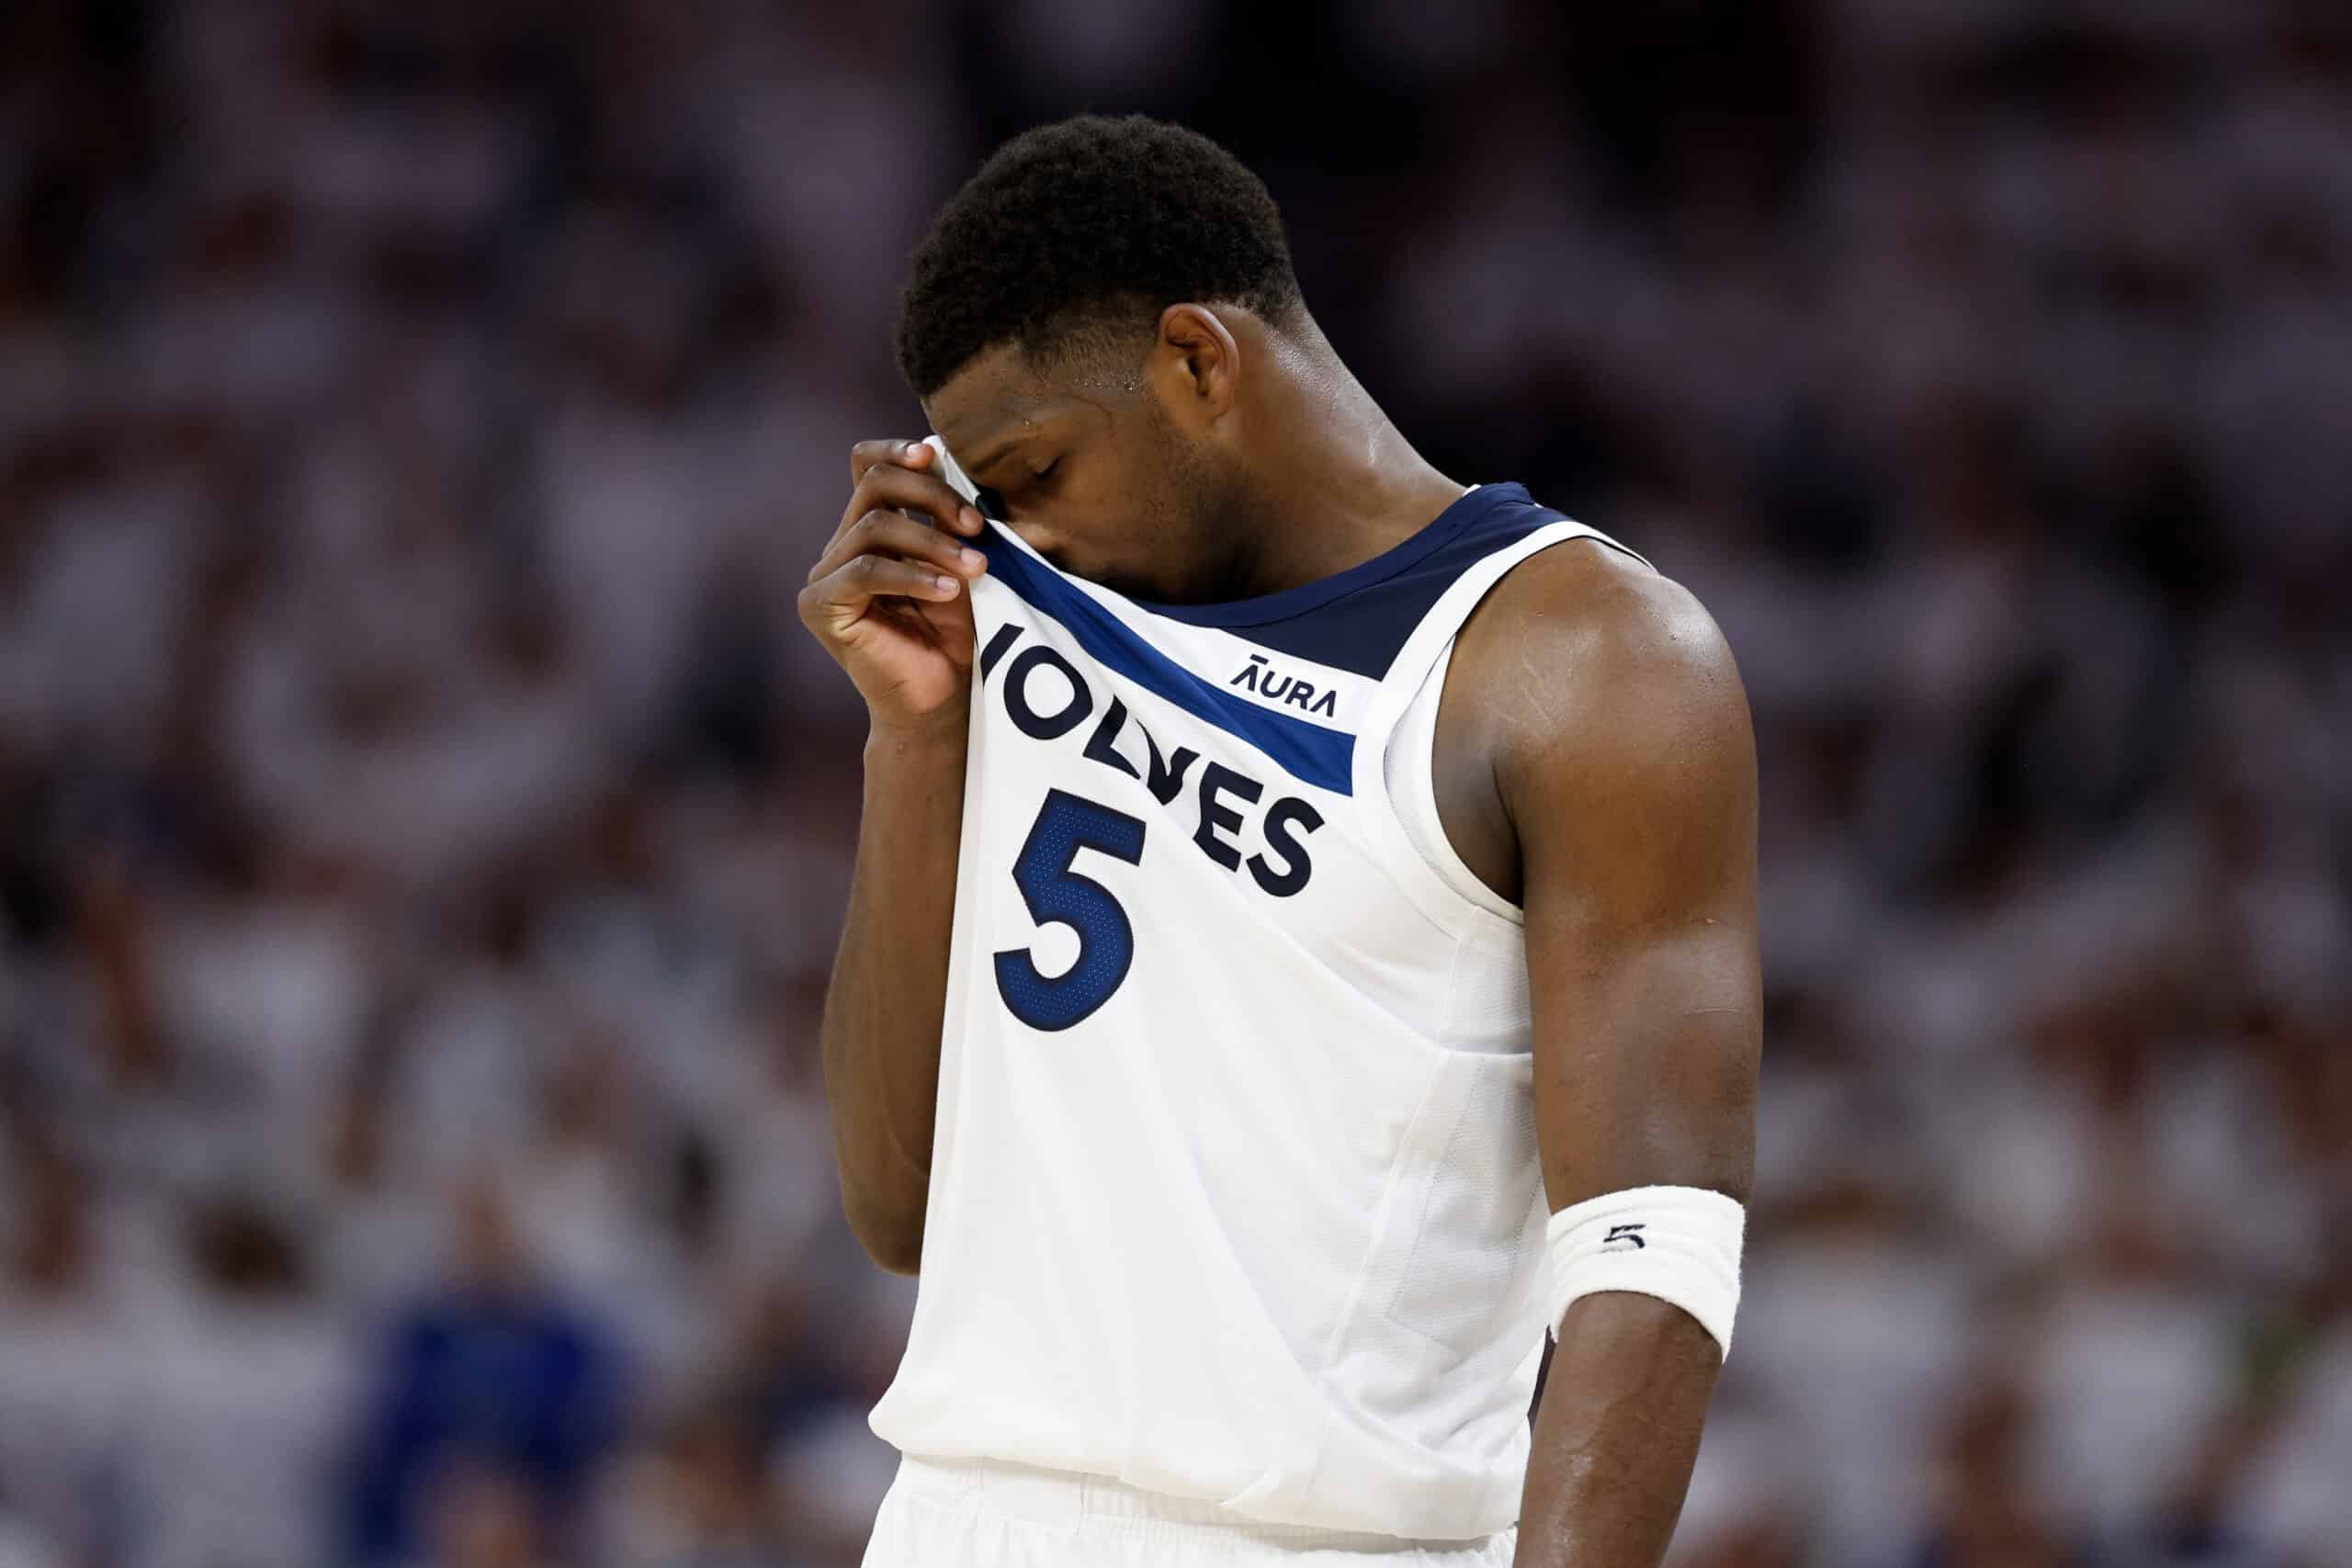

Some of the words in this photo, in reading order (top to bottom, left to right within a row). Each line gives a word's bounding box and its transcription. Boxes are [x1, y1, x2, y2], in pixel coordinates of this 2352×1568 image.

[979, 623, 1325, 897] OLVES
[993, 787, 1147, 1032] 5
[1603, 1224, 1645, 1249] 5
